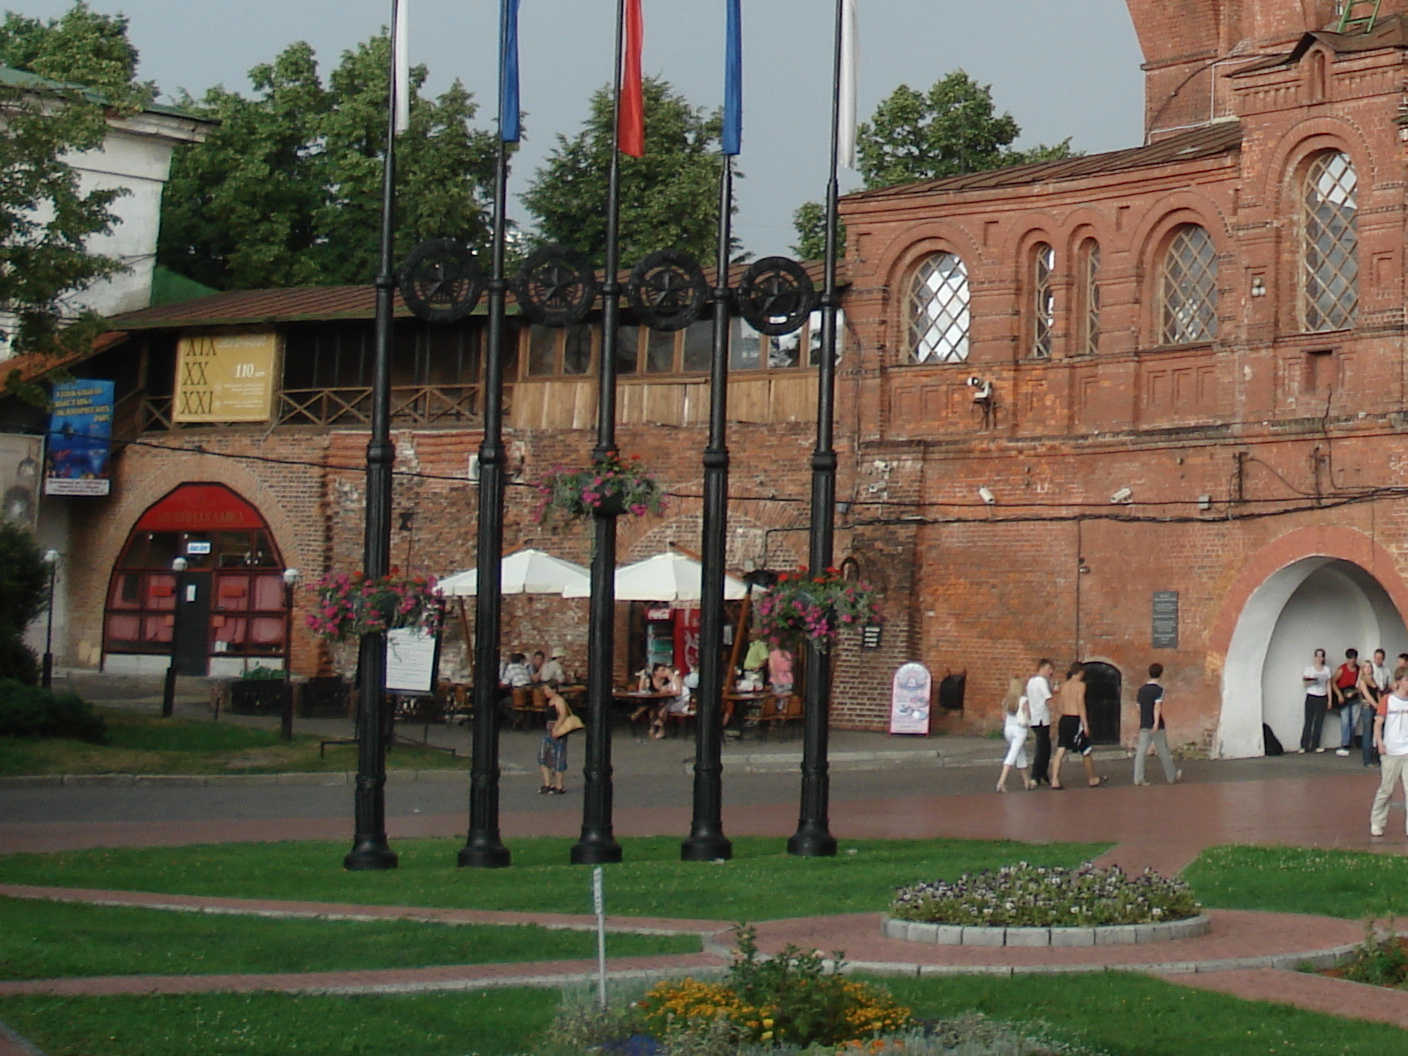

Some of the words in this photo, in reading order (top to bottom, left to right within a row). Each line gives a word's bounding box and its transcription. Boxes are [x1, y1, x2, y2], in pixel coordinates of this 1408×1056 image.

[186, 335, 217, 357] XIX
[182, 361, 209, 386] XX
[235, 363, 255, 378] 110
[180, 390, 213, 415] XXI
